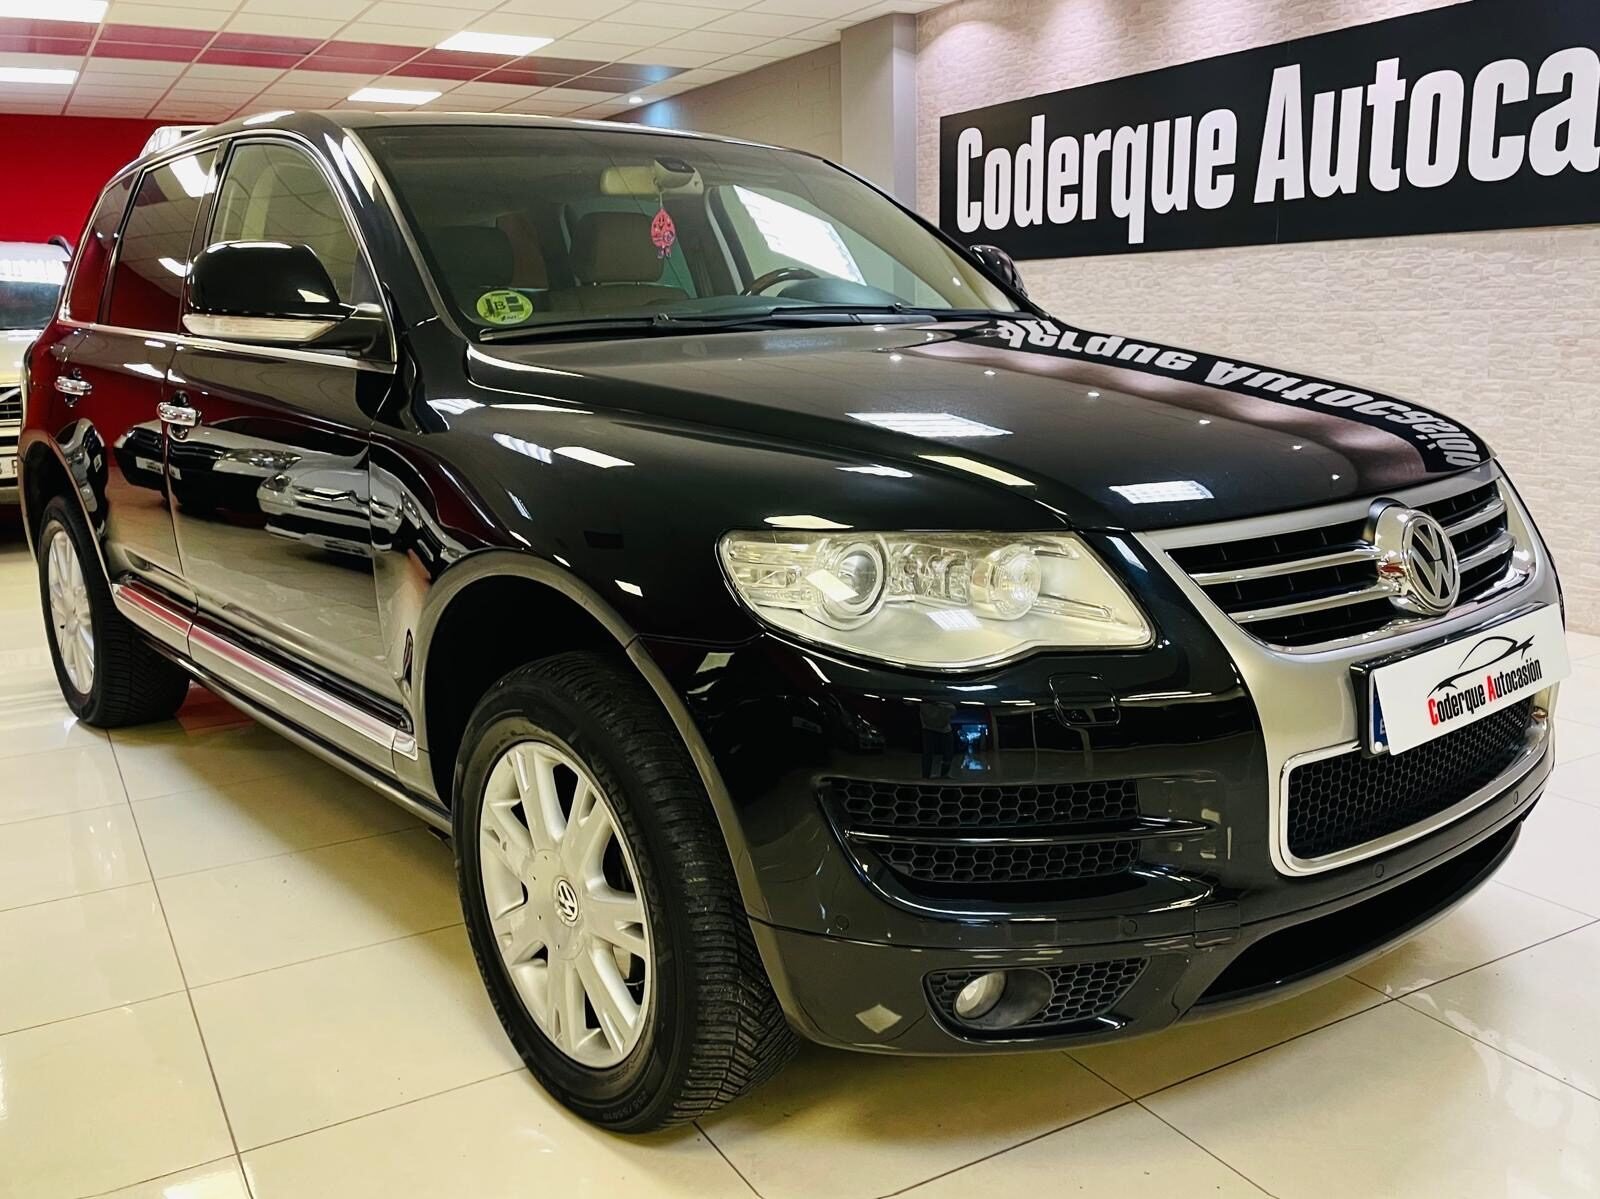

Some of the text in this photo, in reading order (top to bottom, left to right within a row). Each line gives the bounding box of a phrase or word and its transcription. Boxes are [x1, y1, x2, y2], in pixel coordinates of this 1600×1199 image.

[957, 46, 1600, 245] Coderque Autoca
[1428, 657, 1543, 726] Coderque Autocasión
